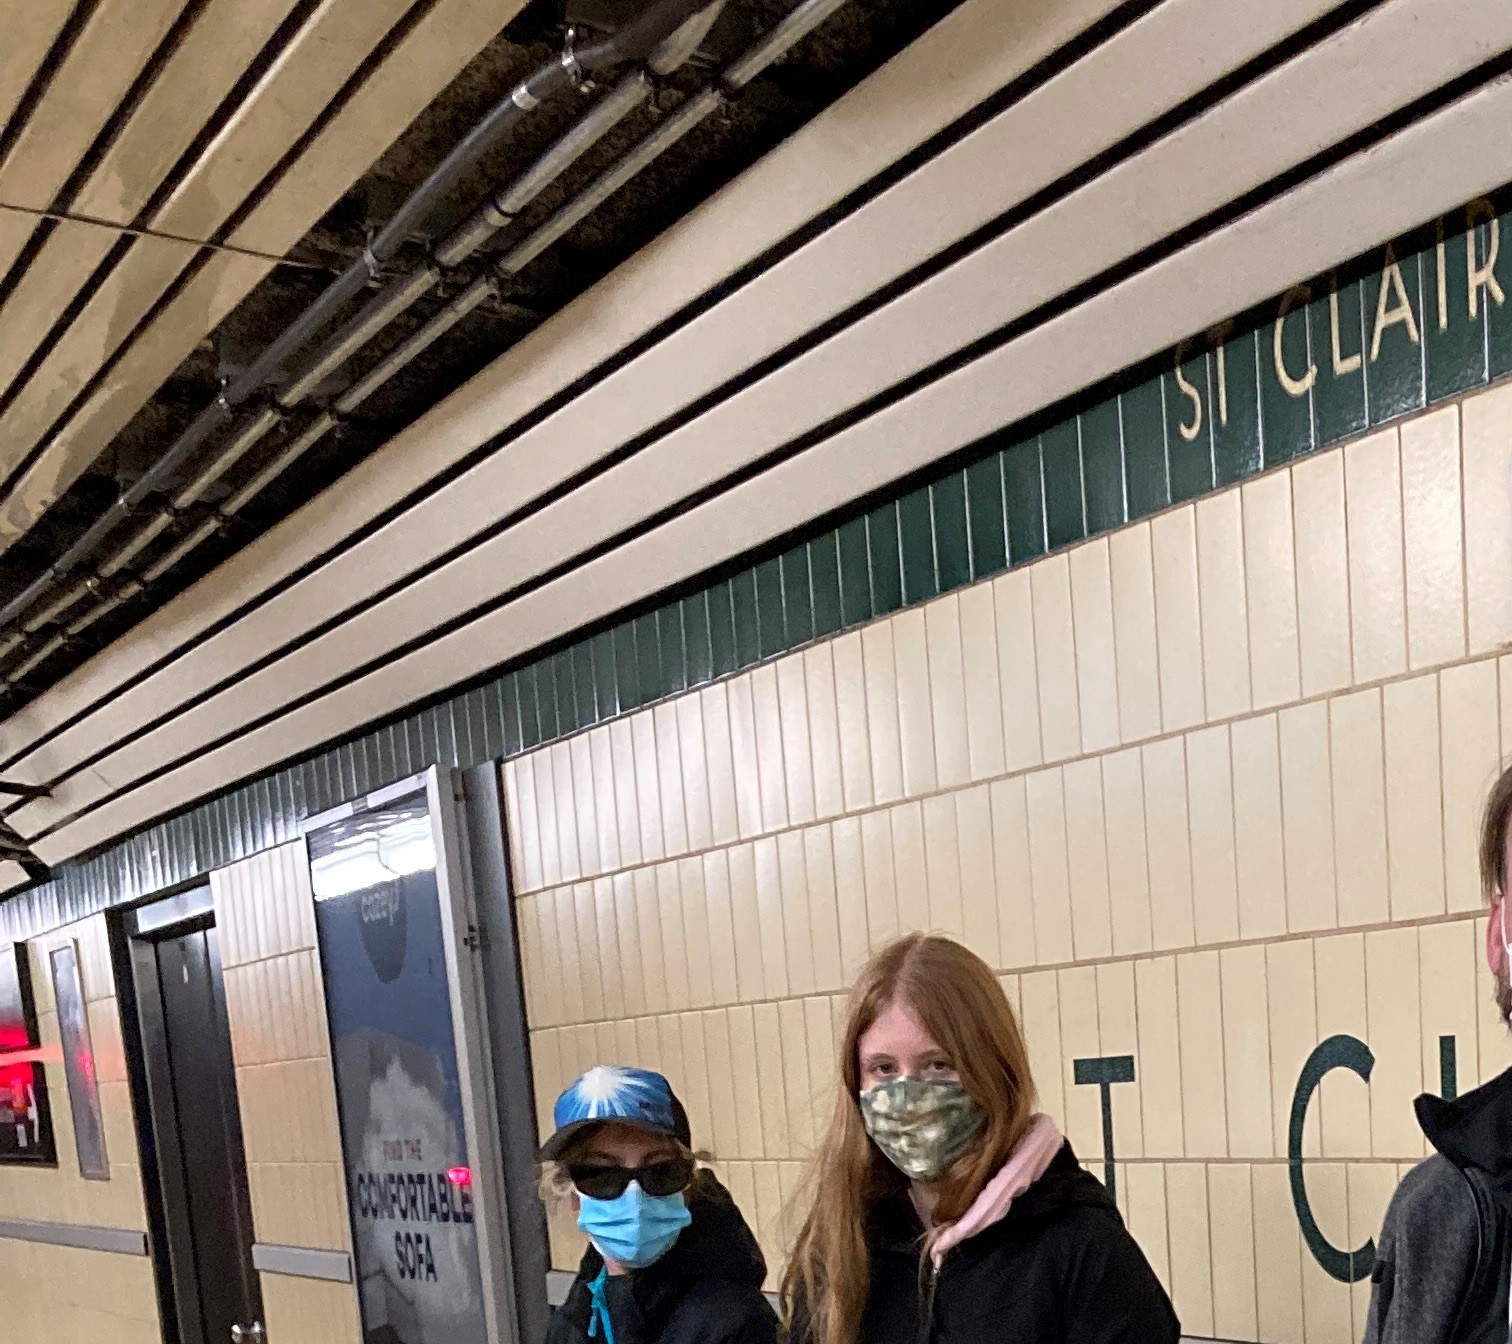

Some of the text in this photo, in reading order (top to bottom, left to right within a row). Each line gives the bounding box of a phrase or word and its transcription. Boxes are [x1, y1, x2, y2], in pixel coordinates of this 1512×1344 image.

[1273, 199, 1506, 398] CLAIR
[1073, 1055, 1135, 1201] T
[357, 1172, 474, 1224] COMFORTABLE
[394, 1231, 438, 1283] SOFA
